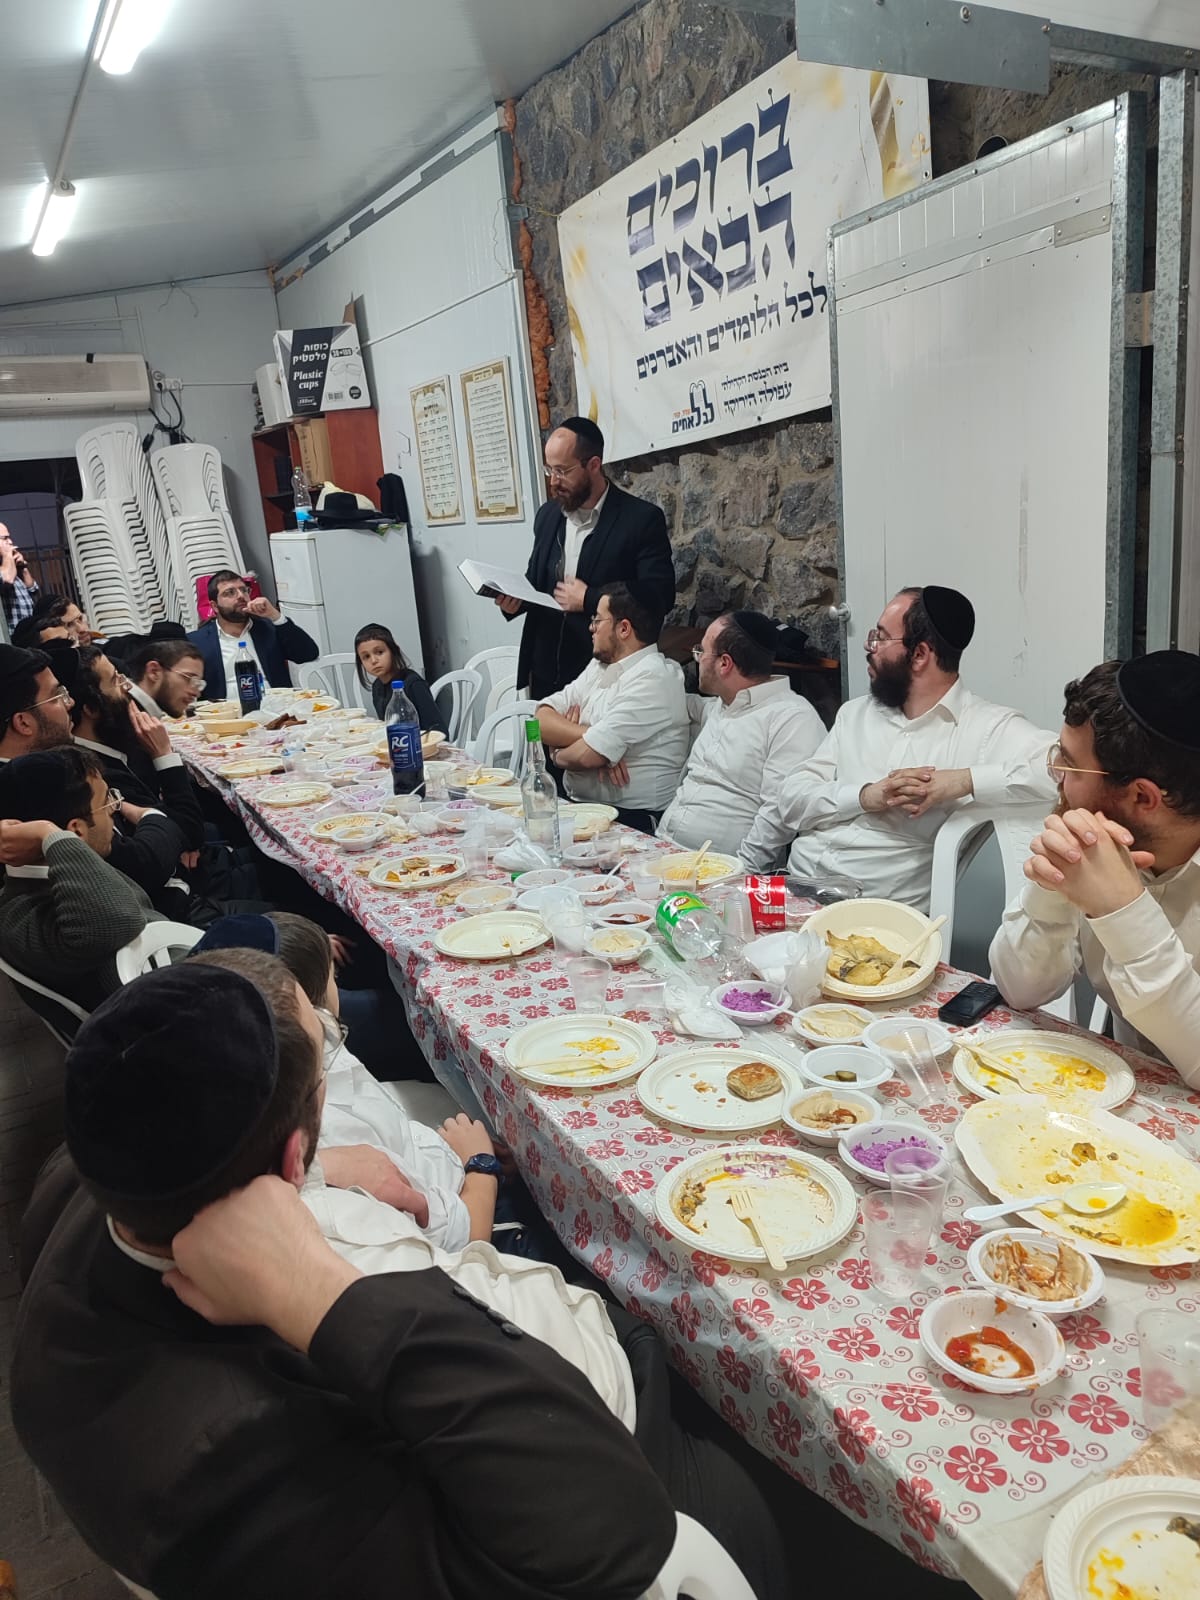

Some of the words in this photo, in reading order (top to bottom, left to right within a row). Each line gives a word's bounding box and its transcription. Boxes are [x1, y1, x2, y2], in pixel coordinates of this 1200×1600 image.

[627, 89, 793, 256] ברוכים
[636, 187, 796, 332] הבאים
[784, 270, 828, 323] לכל
[707, 294, 780, 352] הלומדים
[303, 342, 329, 352] כוסות
[293, 353, 327, 365] פלסטיק
[636, 333, 703, 380] והאברכים
[293, 369, 324, 381] Plastic
[747, 368, 772, 382] הכנסת
[773, 362, 789, 375] בית
[299, 381, 319, 391] cups
[758, 381, 792, 402] עפולה
[724, 392, 757, 416] הירוקה
[240, 676, 253, 688] RC
[391, 735, 409, 751] RC
